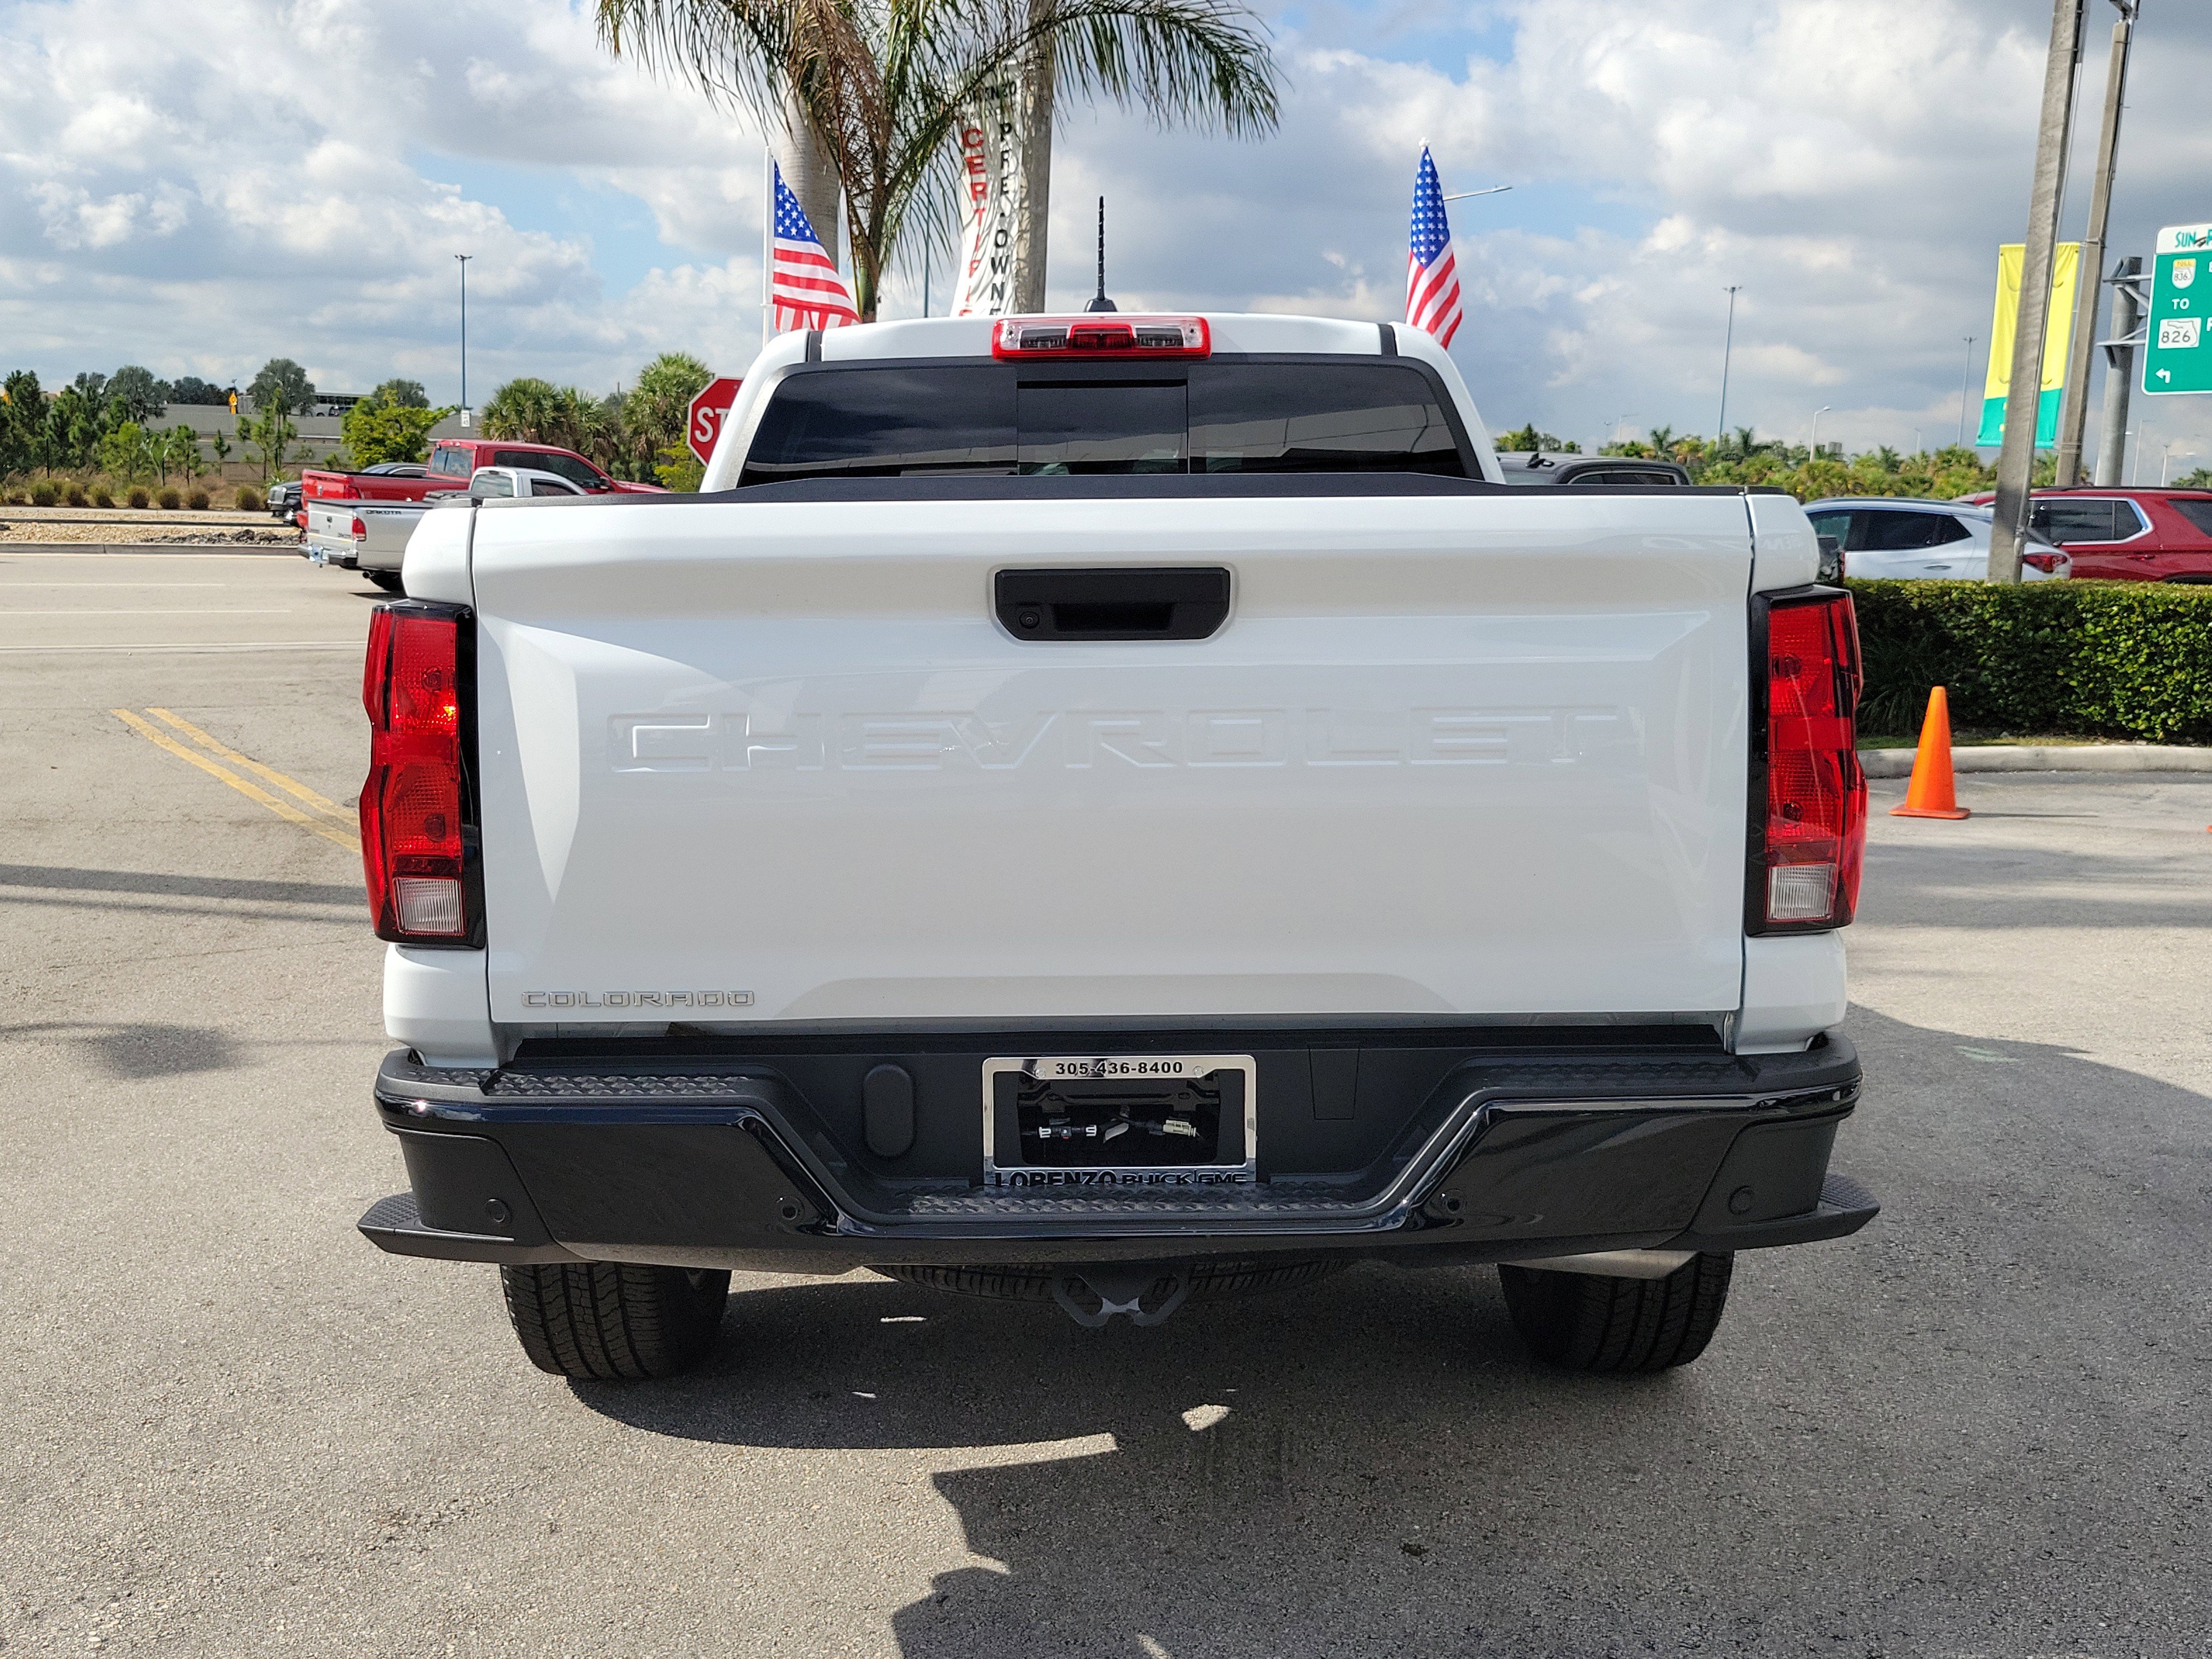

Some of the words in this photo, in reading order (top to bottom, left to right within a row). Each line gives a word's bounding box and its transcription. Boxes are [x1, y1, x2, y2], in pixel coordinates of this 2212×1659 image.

[958, 128, 988, 317] CERTIFI
[989, 122, 1013, 316] PRE-OWN
[2174, 231, 2197, 248] SUN
[2171, 298, 2190, 310] TO
[2161, 330, 2191, 343] 826
[694, 407, 731, 443] ST
[606, 705, 1620, 772] CHEVROLET
[521, 990, 755, 1007] COLORADO
[1055, 1062, 1183, 1075] 305-436-8400
[995, 1170, 1117, 1187] LORENZO
